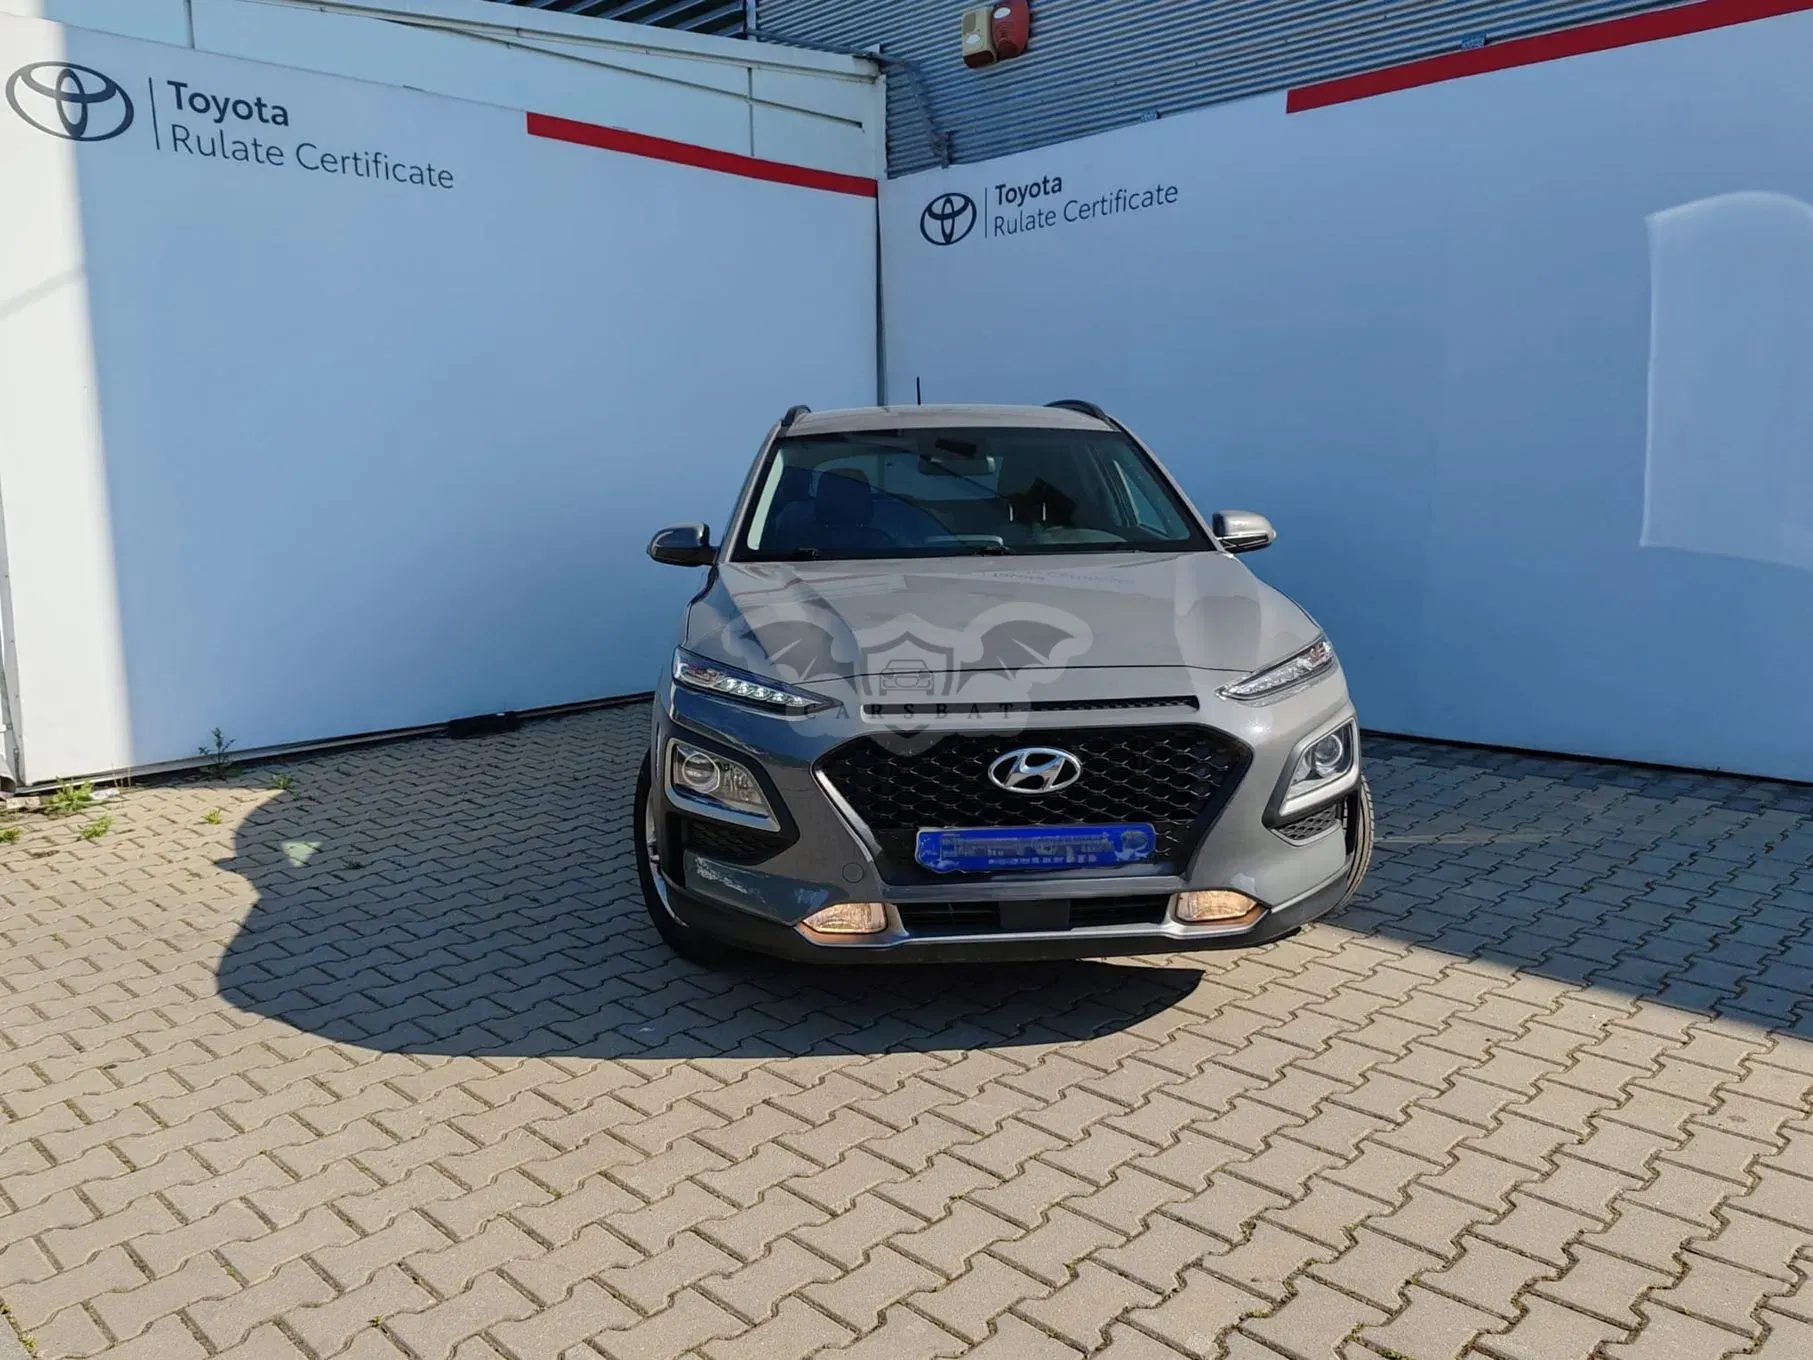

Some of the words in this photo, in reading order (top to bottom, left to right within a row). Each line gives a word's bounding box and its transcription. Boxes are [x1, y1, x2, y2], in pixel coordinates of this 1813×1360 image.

[166, 80, 289, 127] Toyota
[171, 123, 285, 166] Rulate
[295, 142, 455, 189] Certificate
[993, 209, 1057, 237] Rulate
[1062, 184, 1179, 223] Certificate
[995, 175, 1062, 206] Toyota
